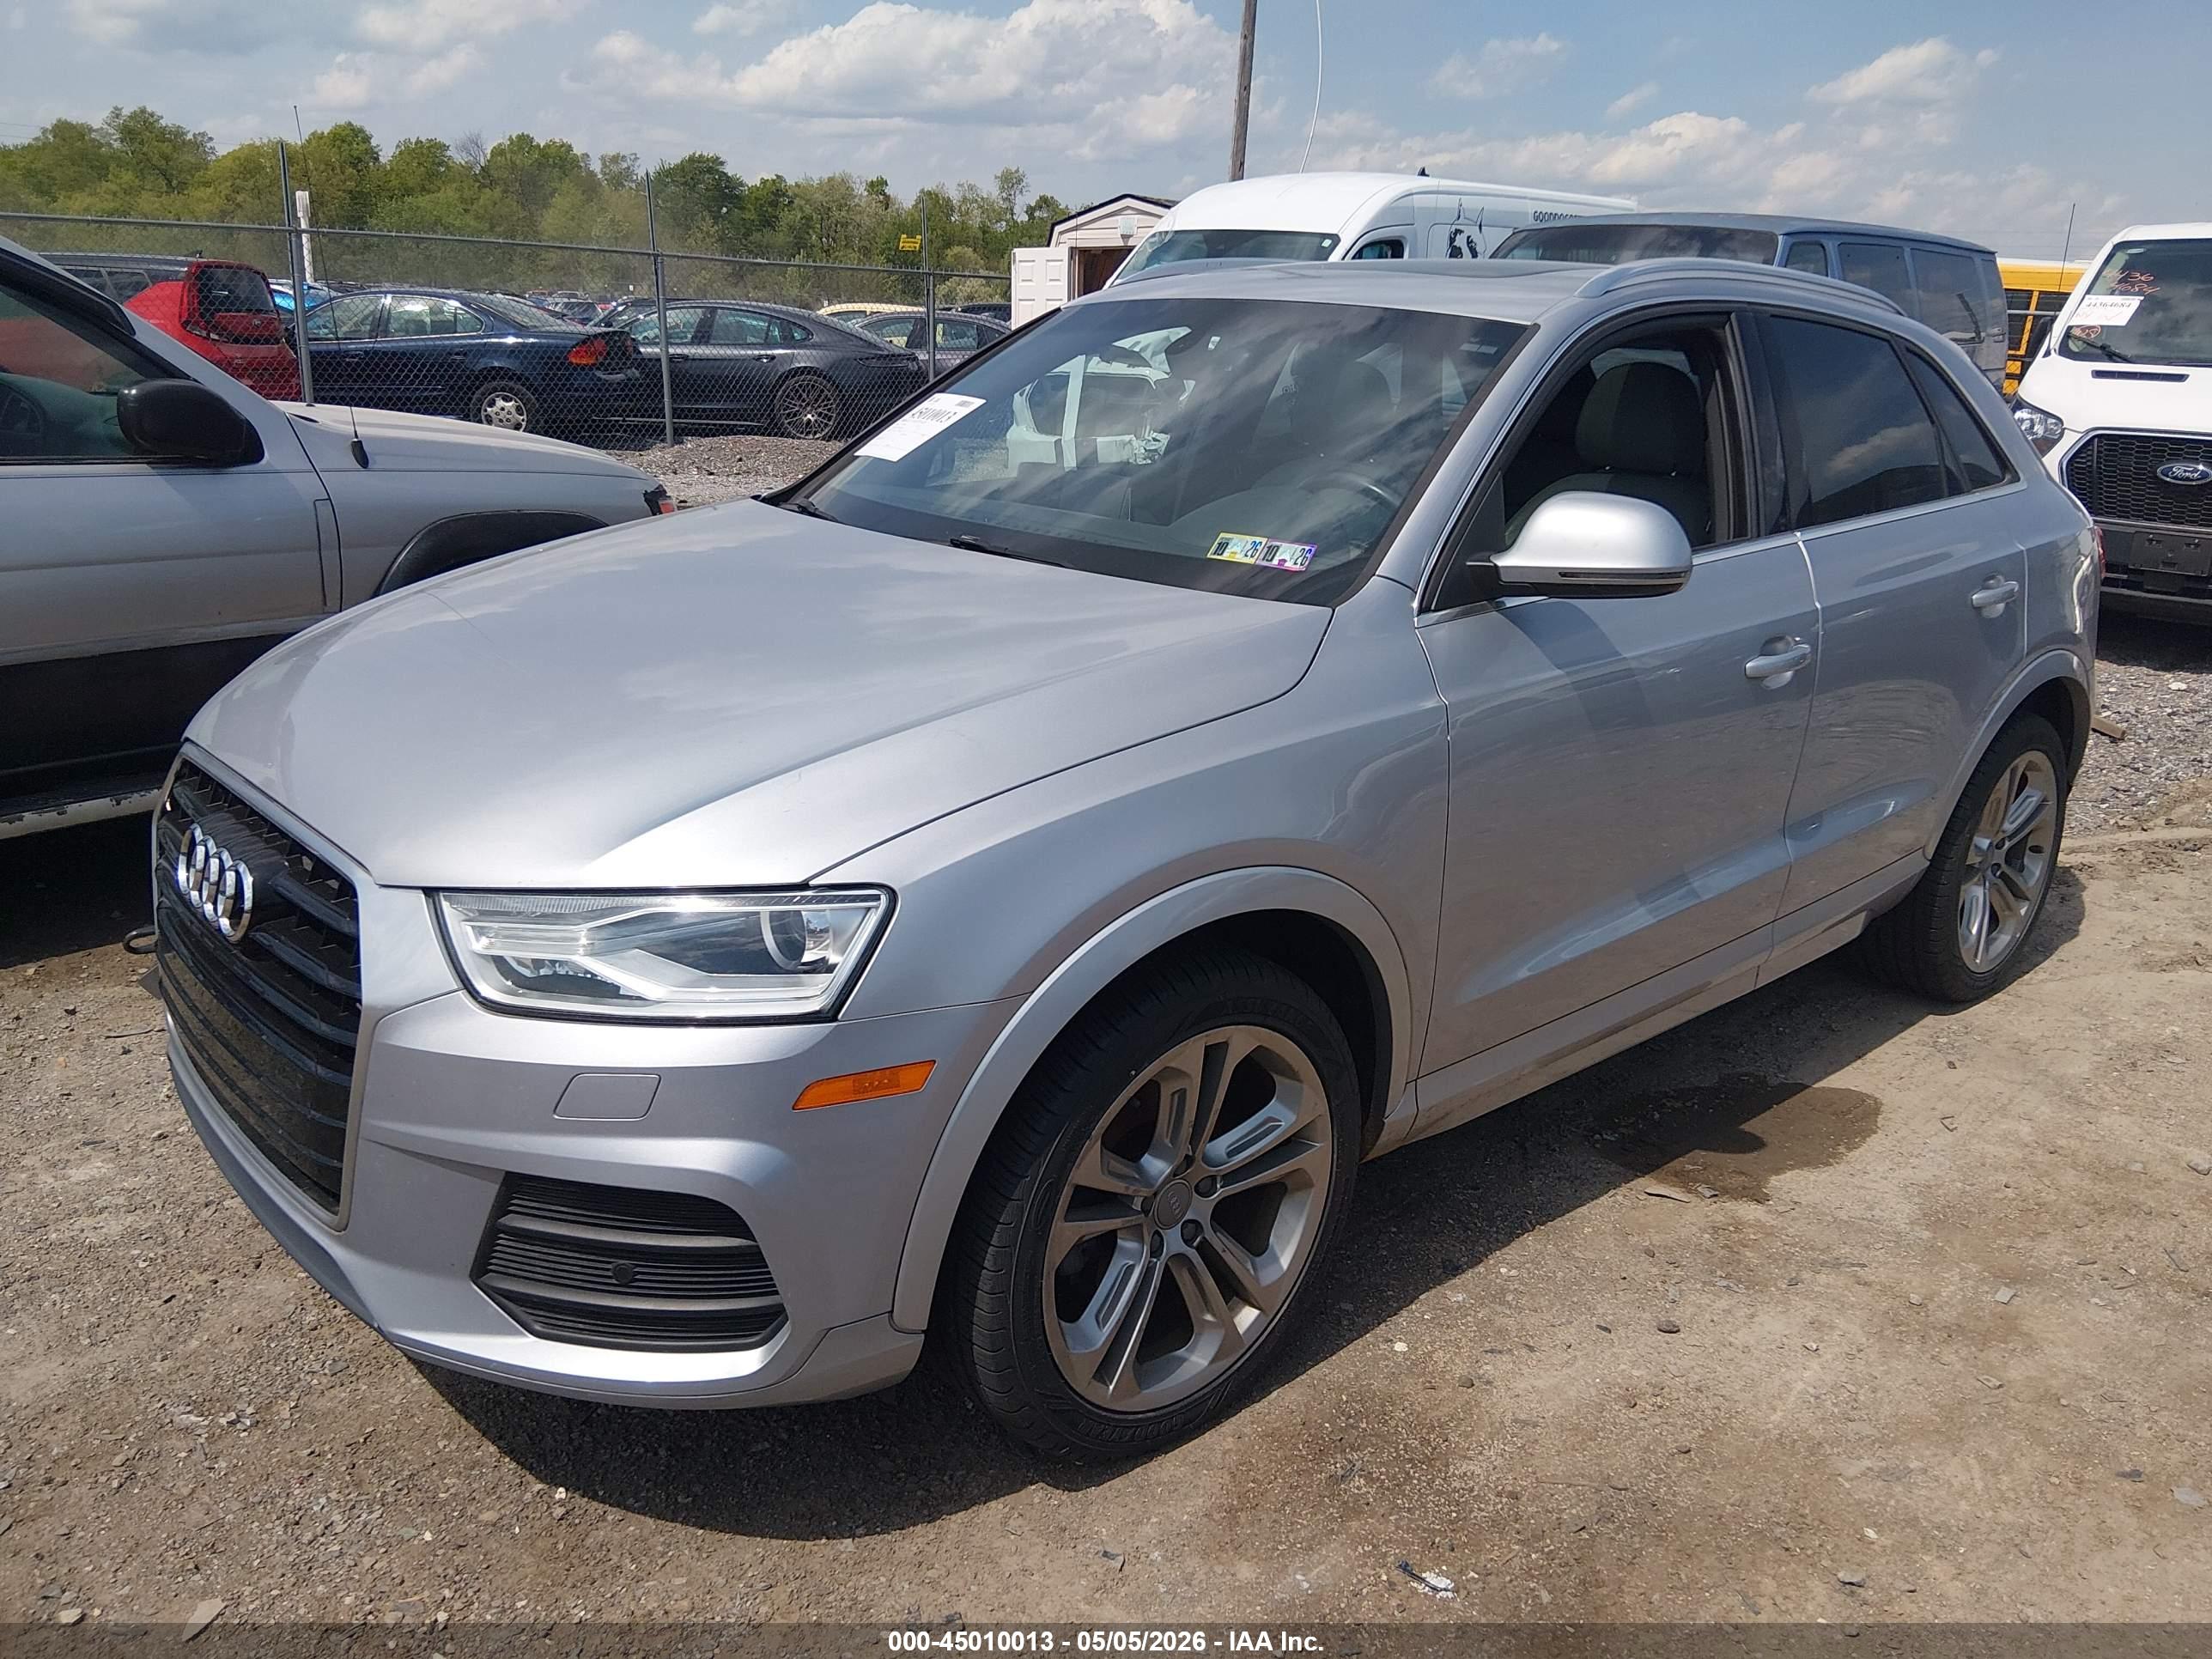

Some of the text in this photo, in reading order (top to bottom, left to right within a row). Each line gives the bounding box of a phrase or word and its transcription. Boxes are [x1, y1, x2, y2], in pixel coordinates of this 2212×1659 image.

[2168, 466, 2202, 479] Ford
[1212, 540, 1262, 558] 10 26
[1261, 544, 1313, 567] 10 26
